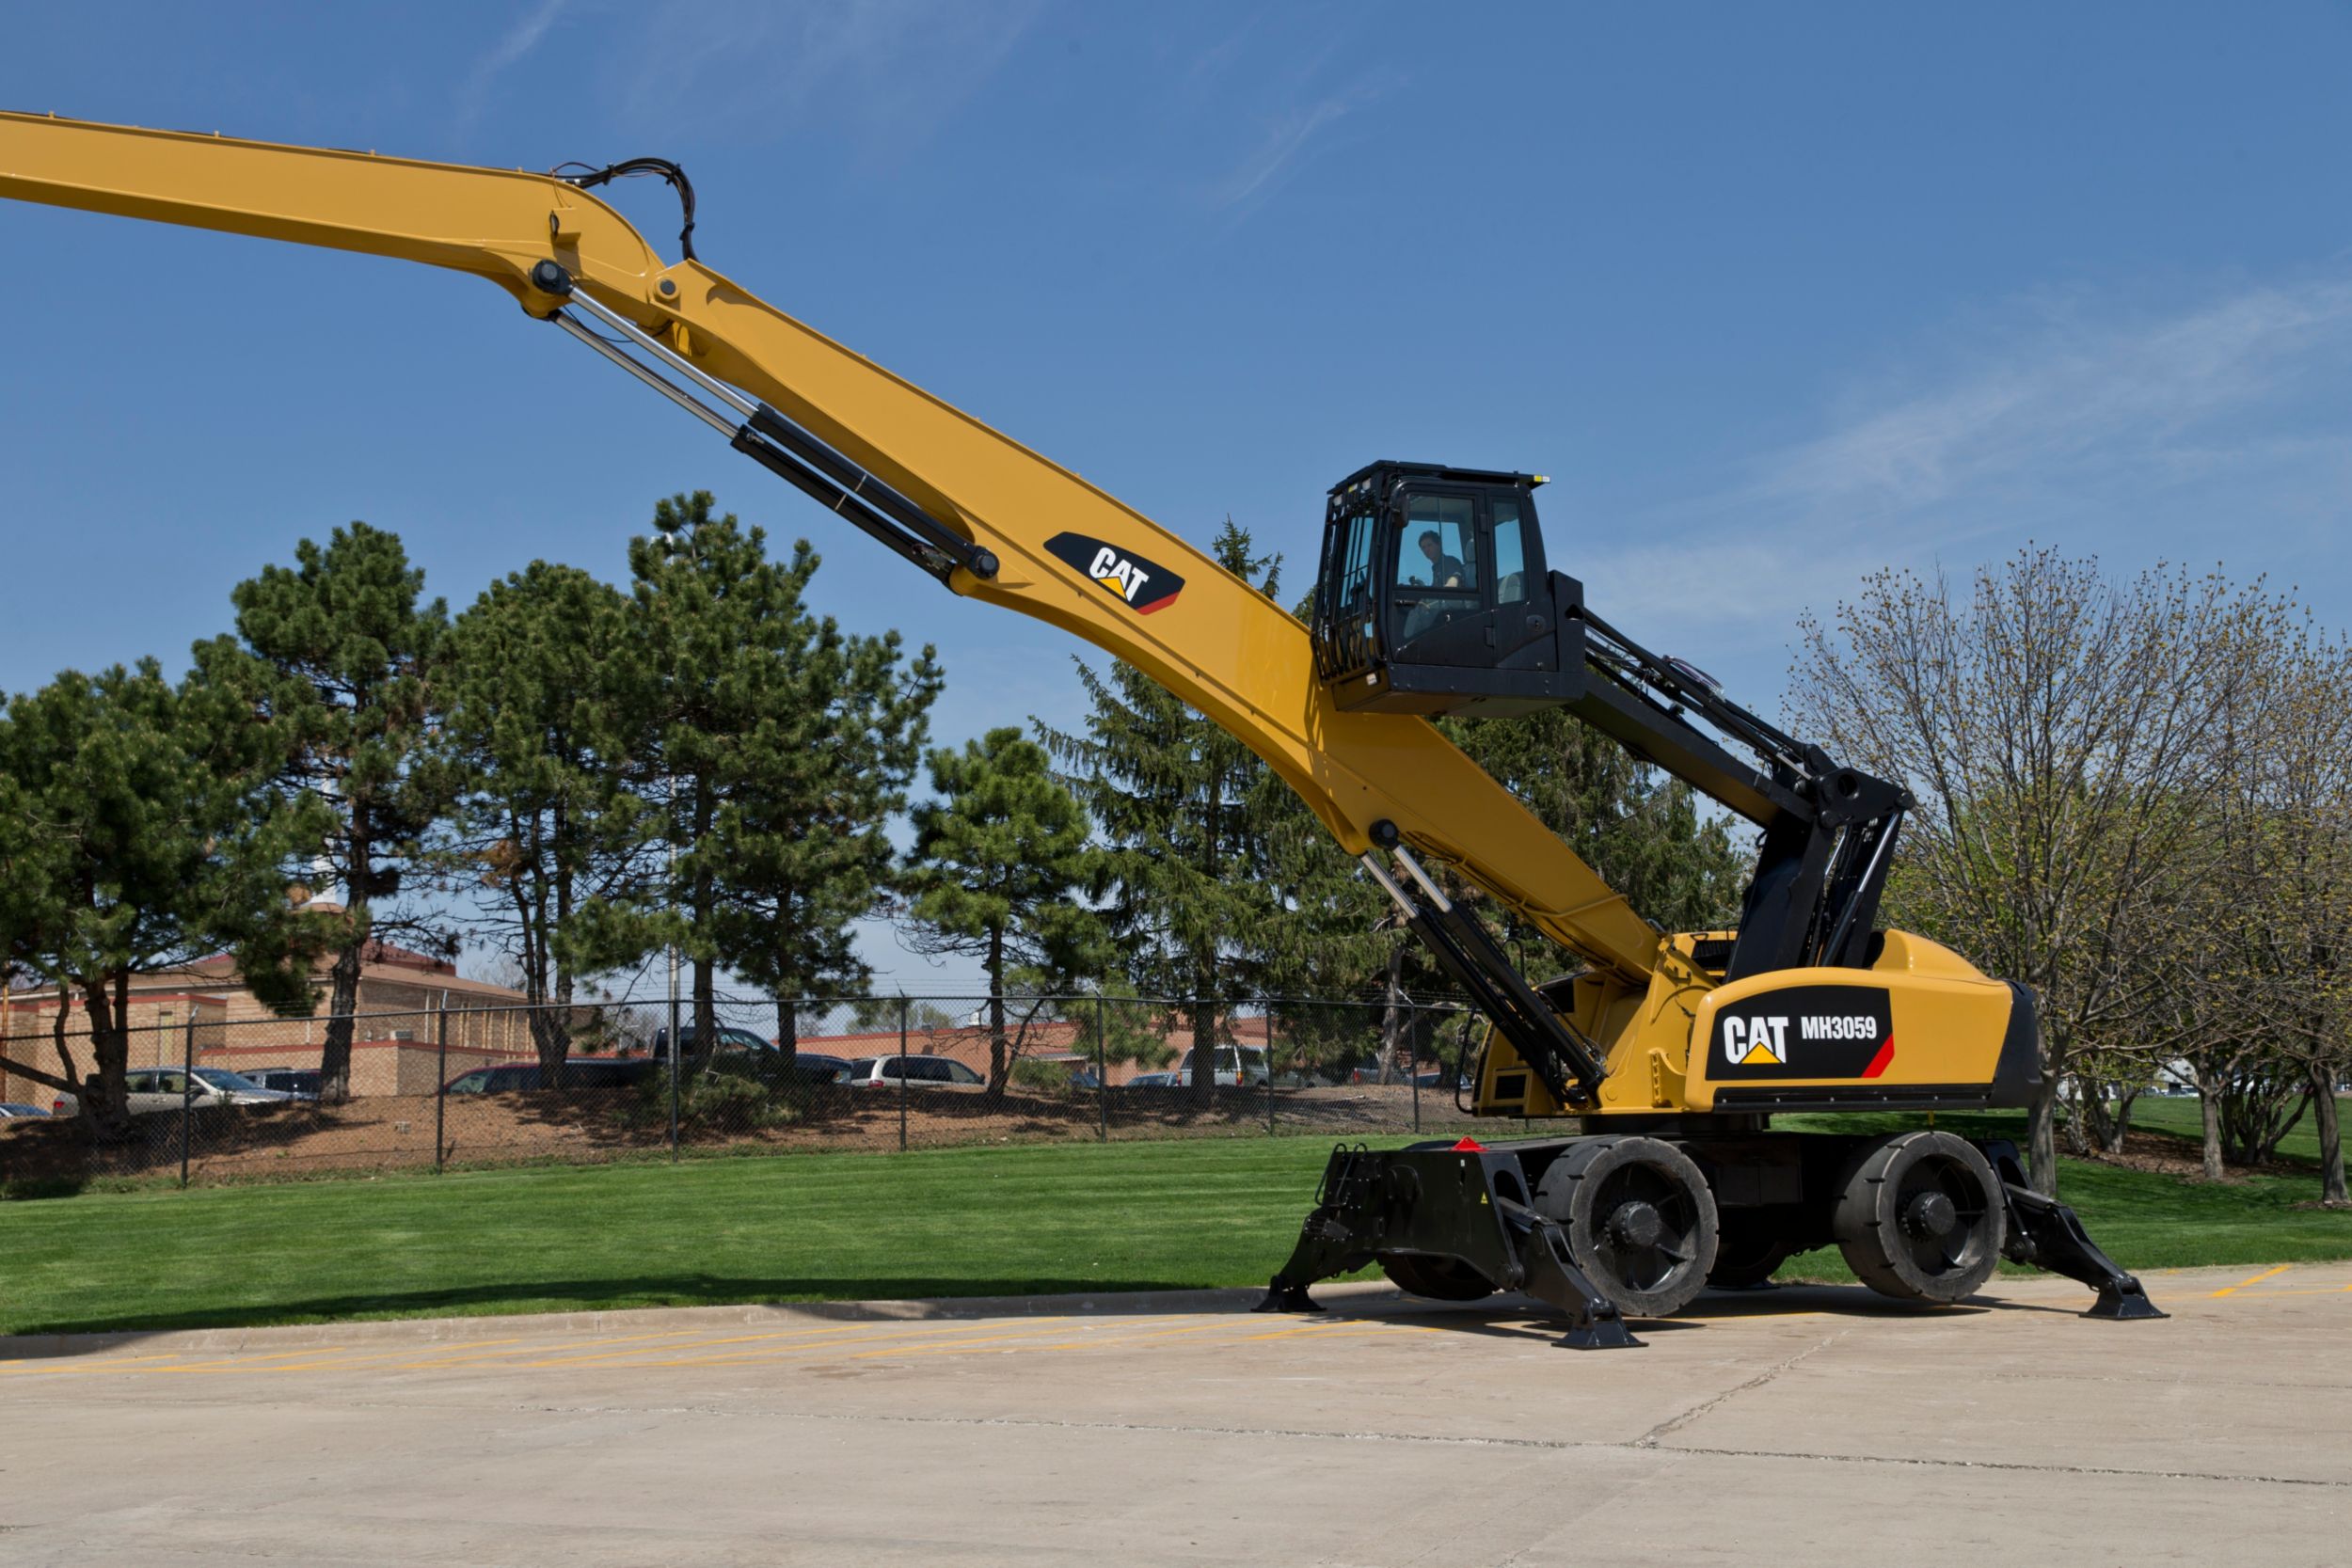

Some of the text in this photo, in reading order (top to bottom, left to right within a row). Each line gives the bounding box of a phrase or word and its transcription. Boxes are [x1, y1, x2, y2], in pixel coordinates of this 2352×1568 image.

[1089, 546, 1150, 602] CAT
[1723, 1016, 1877, 1064] CAT MH3059
